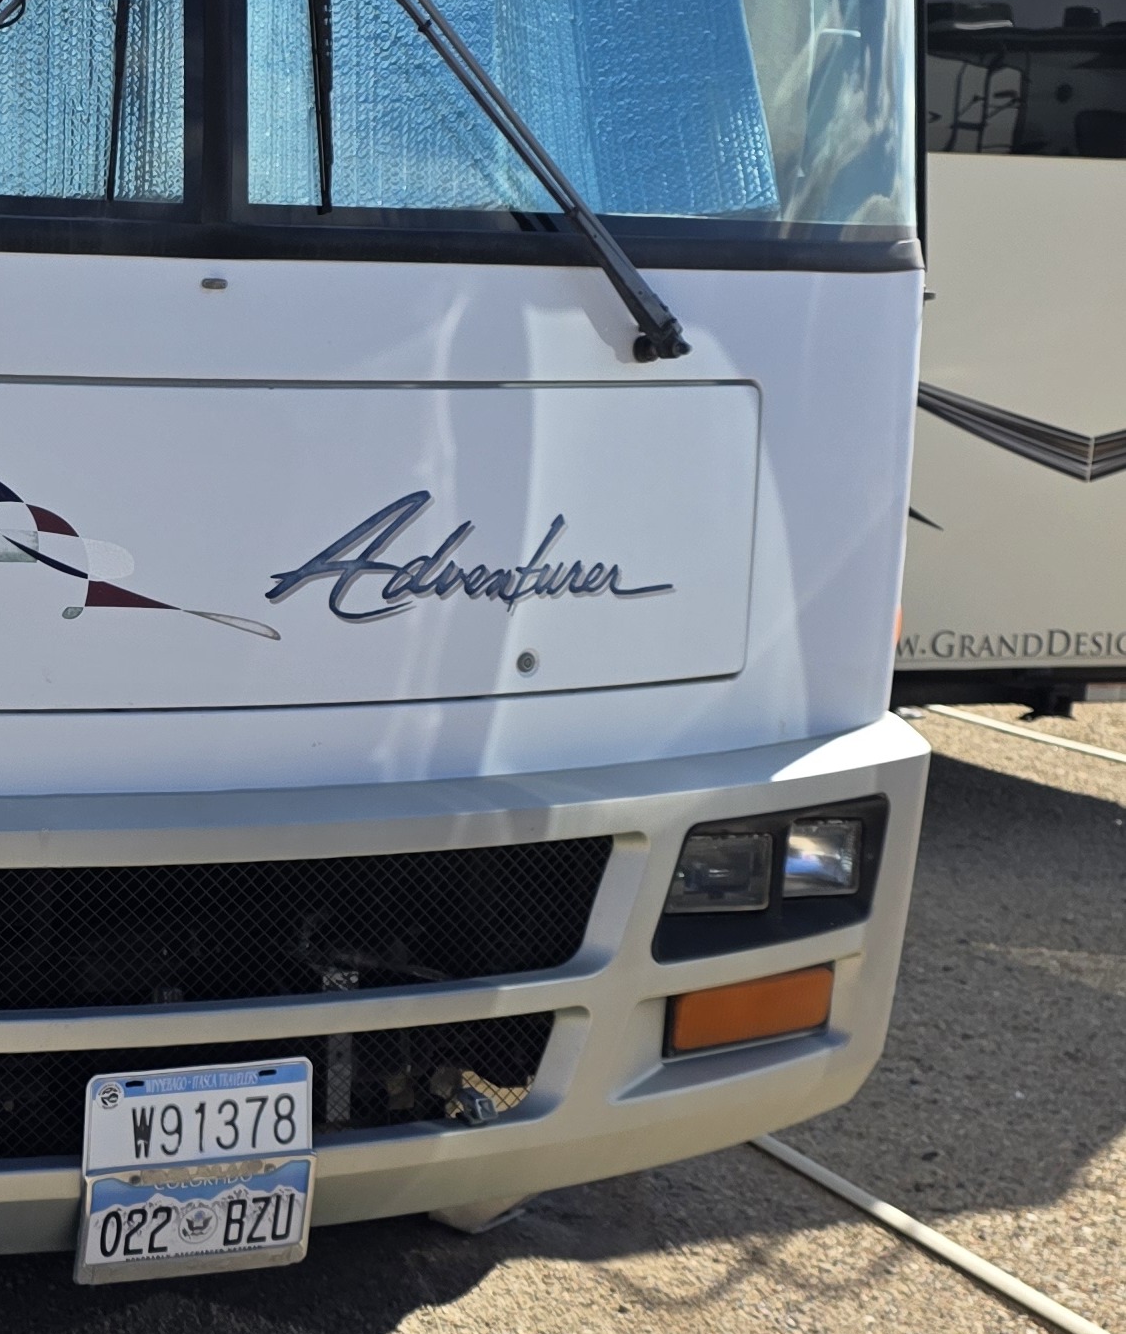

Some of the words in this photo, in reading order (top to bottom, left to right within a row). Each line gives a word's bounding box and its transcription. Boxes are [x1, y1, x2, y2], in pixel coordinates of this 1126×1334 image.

[265, 490, 674, 623] Adventurer
[132, 1093, 296, 1159] W91378
[100, 1206, 173, 1258] 022
[223, 1193, 296, 1246] BZU
